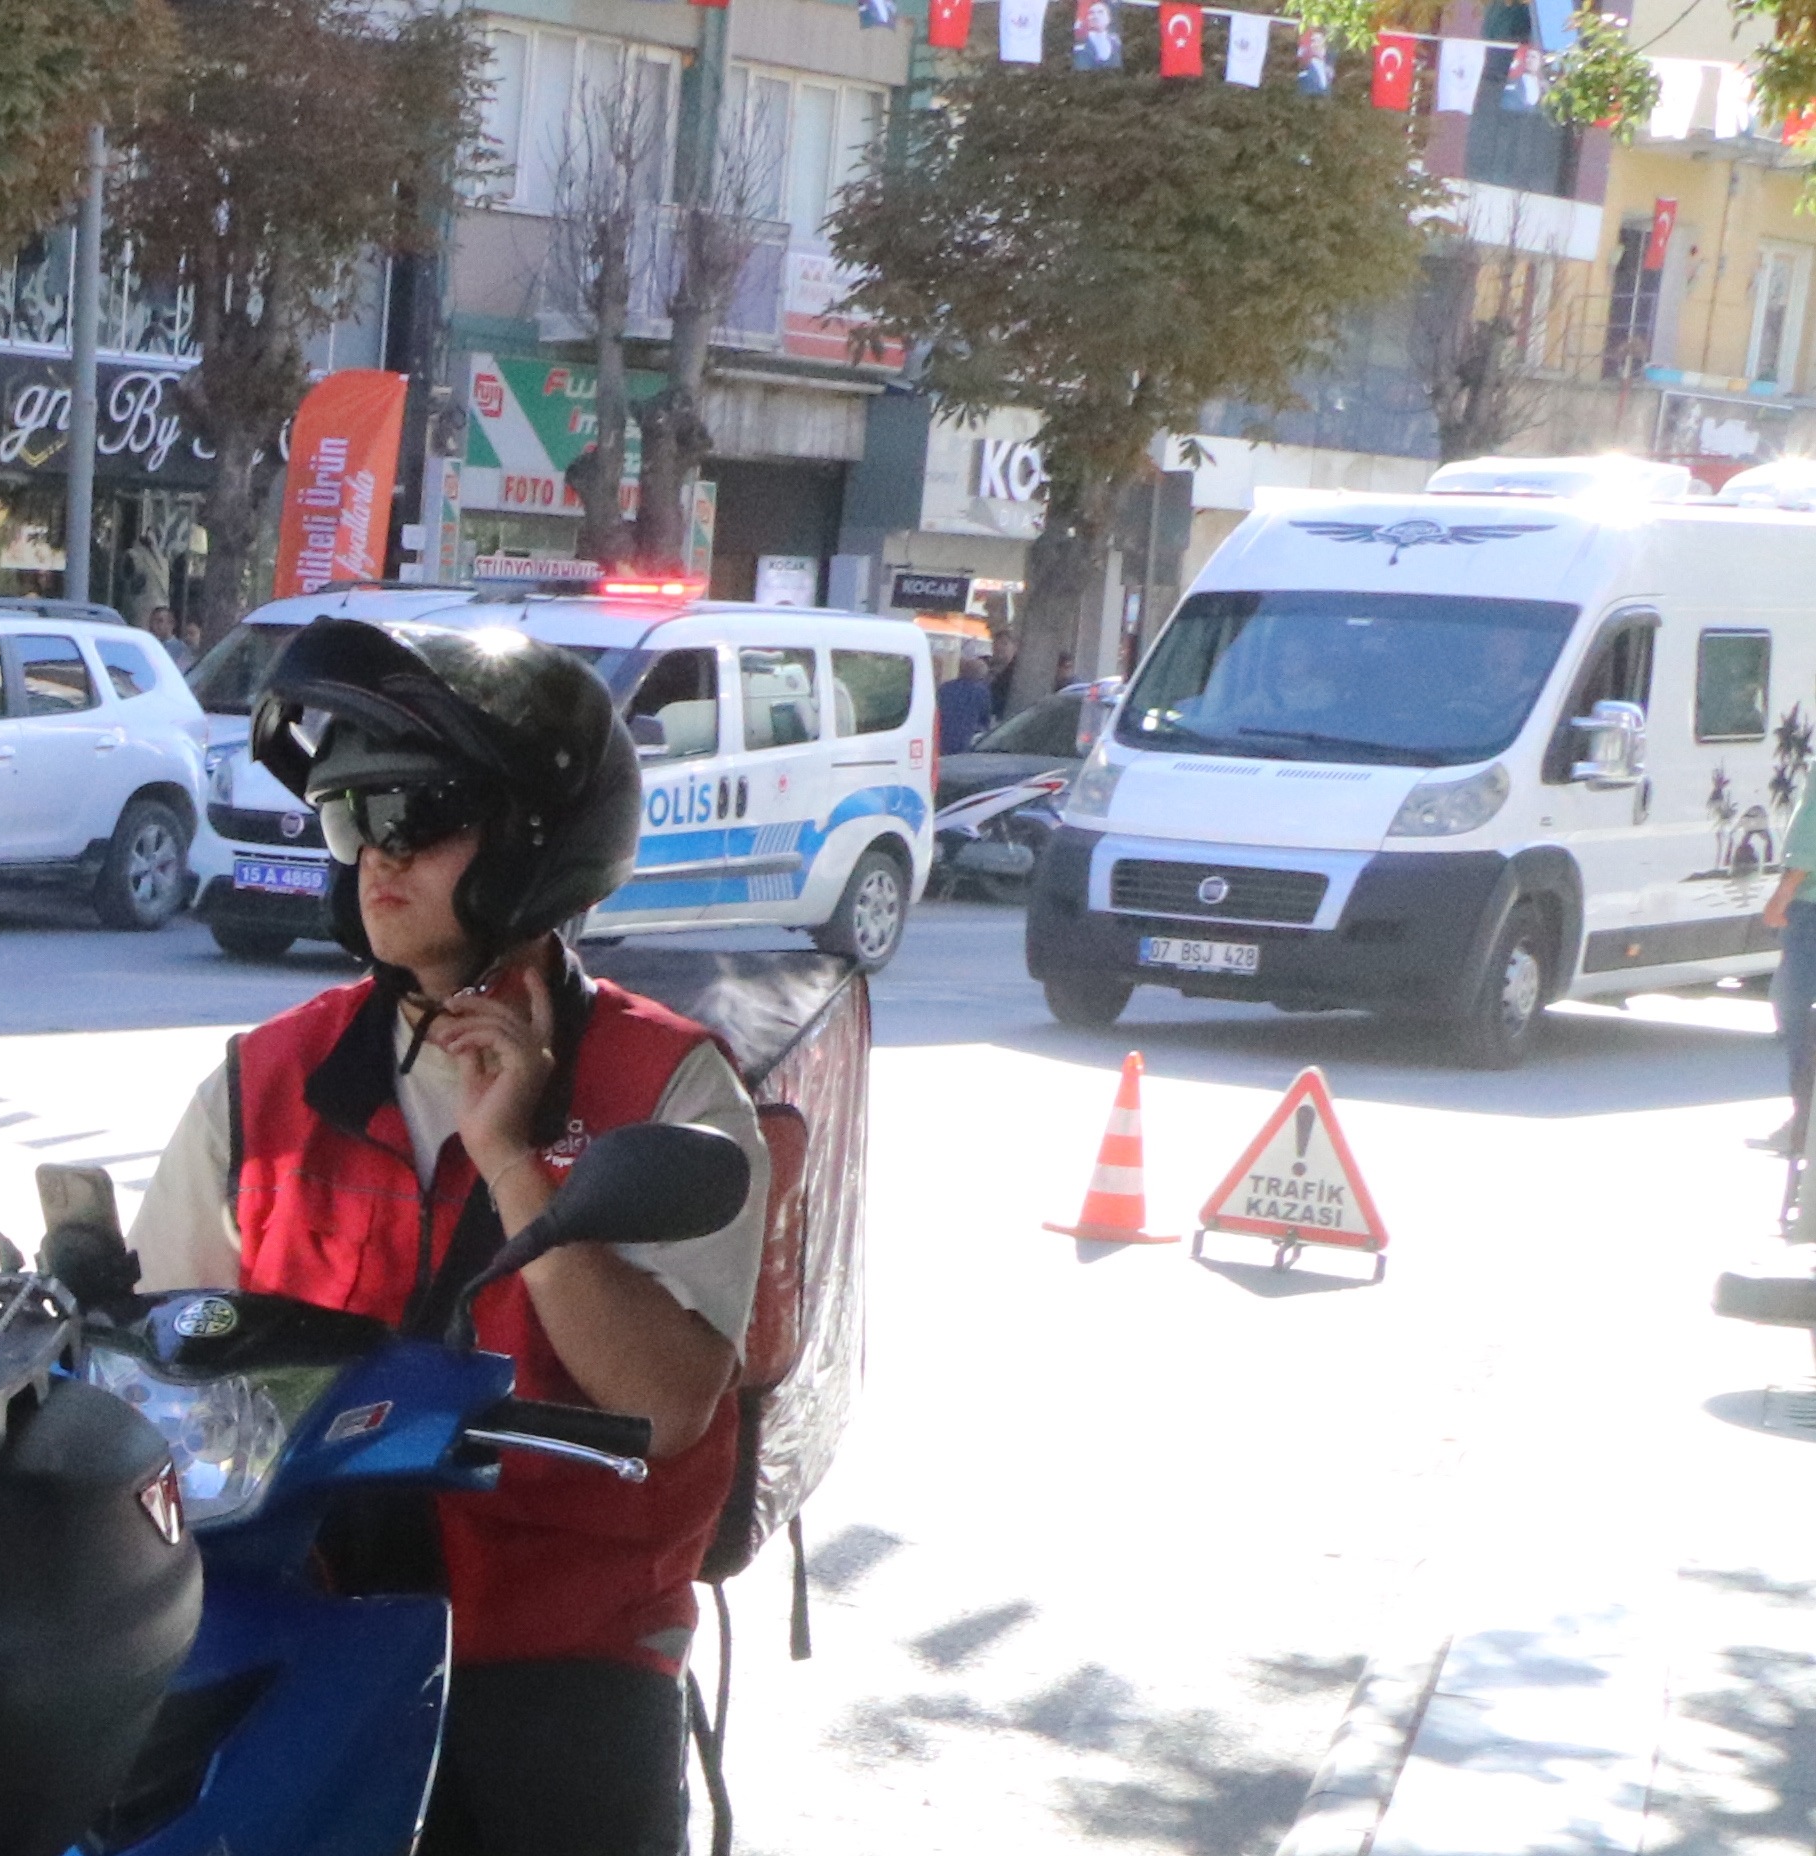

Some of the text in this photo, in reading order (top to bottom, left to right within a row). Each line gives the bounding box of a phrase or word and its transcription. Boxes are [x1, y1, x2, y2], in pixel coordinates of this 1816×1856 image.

[297, 436, 351, 509] Ürün
[504, 475, 555, 506] FOTO
[640, 774, 713, 828] OLİS
[241, 866, 324, 889] 15 A 4859
[1150, 939, 1256, 968] 07 BSJ 428
[1249, 1174, 1345, 1206] TRAFİK
[1245, 1196, 1342, 1228] KAZASI
